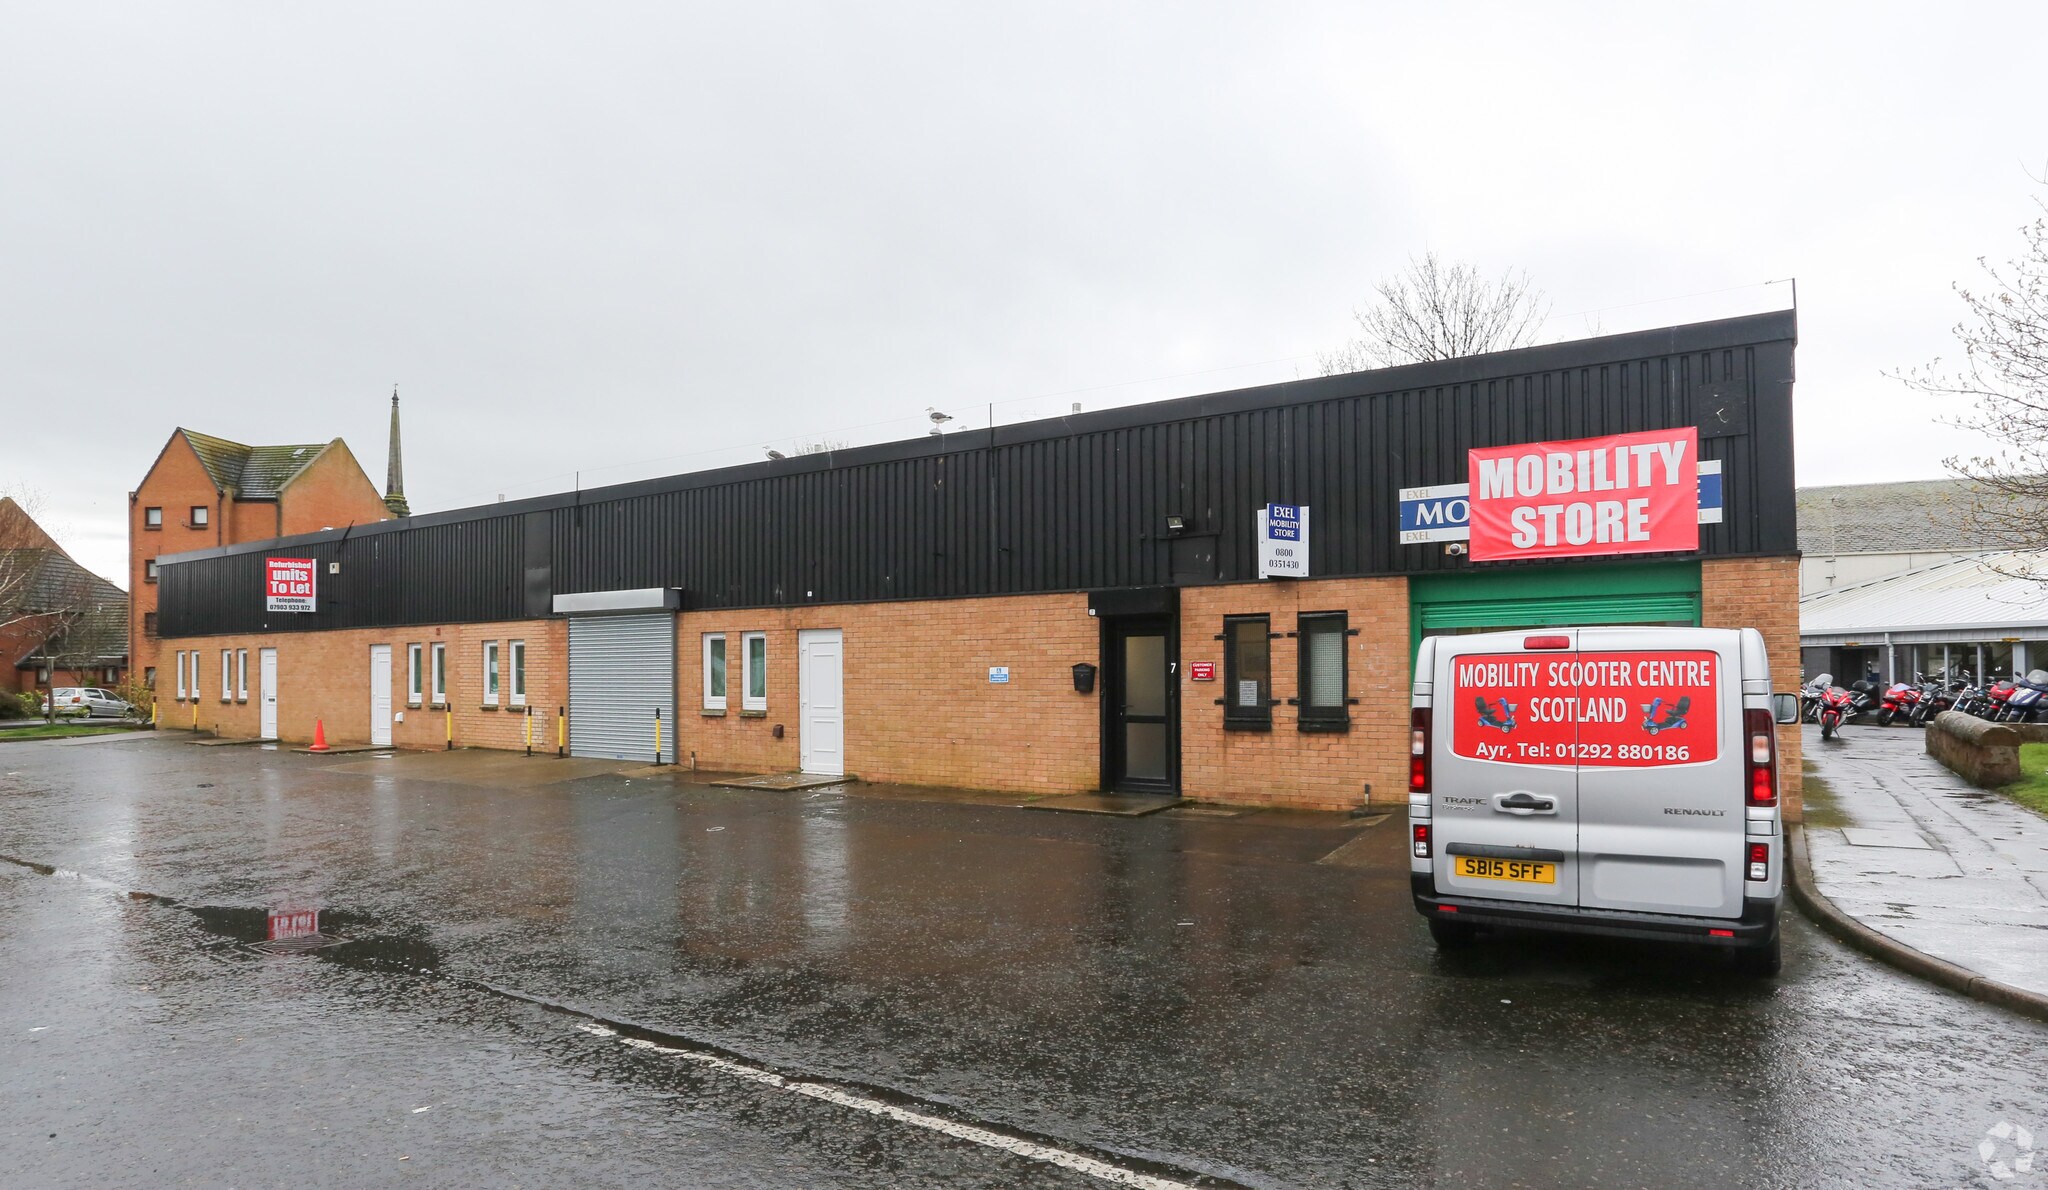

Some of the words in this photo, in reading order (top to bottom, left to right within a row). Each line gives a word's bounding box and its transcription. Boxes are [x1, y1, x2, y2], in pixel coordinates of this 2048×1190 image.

[1479, 440, 1687, 500] MOBILITY
[1406, 489, 1431, 500] EXEL
[1274, 506, 1295, 519] EXEL
[1269, 519, 1300, 529] MOBILITY
[1511, 498, 1650, 549] STORE
[1274, 529, 1295, 538] STORE
[1406, 531, 1430, 541] EXEL
[1275, 548, 1293, 557] 0800
[1269, 560, 1299, 569] 0351430
[272, 569, 308, 581] units
[270, 581, 287, 594] To
[290, 581, 311, 594] Let
[1170, 662, 1177, 673] 7
[1459, 662, 1540, 688] MOBILITY
[1548, 661, 1632, 687] SCOOTER
[1636, 660, 1710, 687] CENTRE
[1530, 697, 1627, 723] SCOTLAND
[1475, 742, 1512, 760] Ayr,
[1517, 742, 1551, 757] Tel:
[1555, 743, 1612, 759] 01292
[1617, 744, 1690, 761] 880186
[1443, 796, 1488, 806] TRAFIC
[1663, 807, 1727, 817] RENAULT
[1465, 859, 1504, 877] SB15
[1509, 863, 1544, 880] SFF
